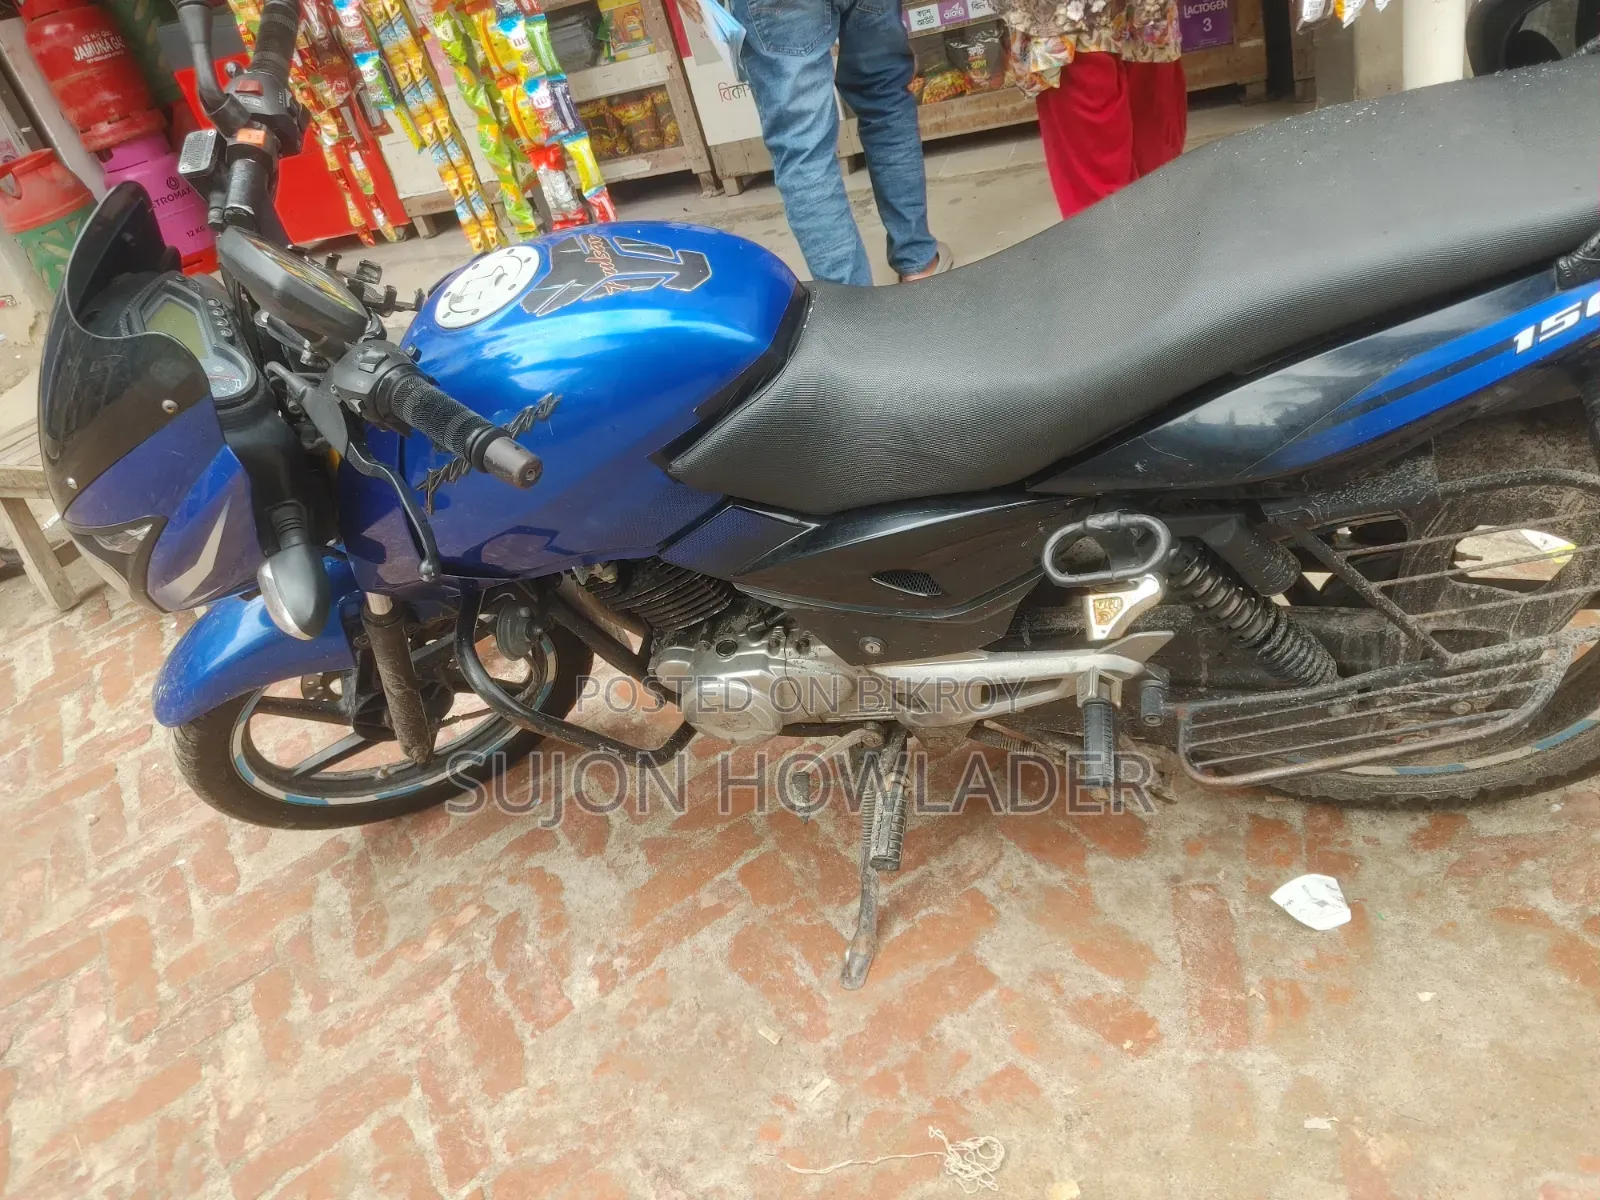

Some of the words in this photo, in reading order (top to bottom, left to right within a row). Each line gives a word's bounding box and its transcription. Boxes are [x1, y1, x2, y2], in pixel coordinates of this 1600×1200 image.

[1183, 0, 1228, 18] LACTOGEN
[1202, 17, 1213, 32] 3
[73, 38, 114, 61] JAMUNA
[717, 81, 751, 103] বিকা
[153, 186, 192, 209] TROMAX
[186, 230, 196, 238] 12
[195, 225, 206, 235] KG
